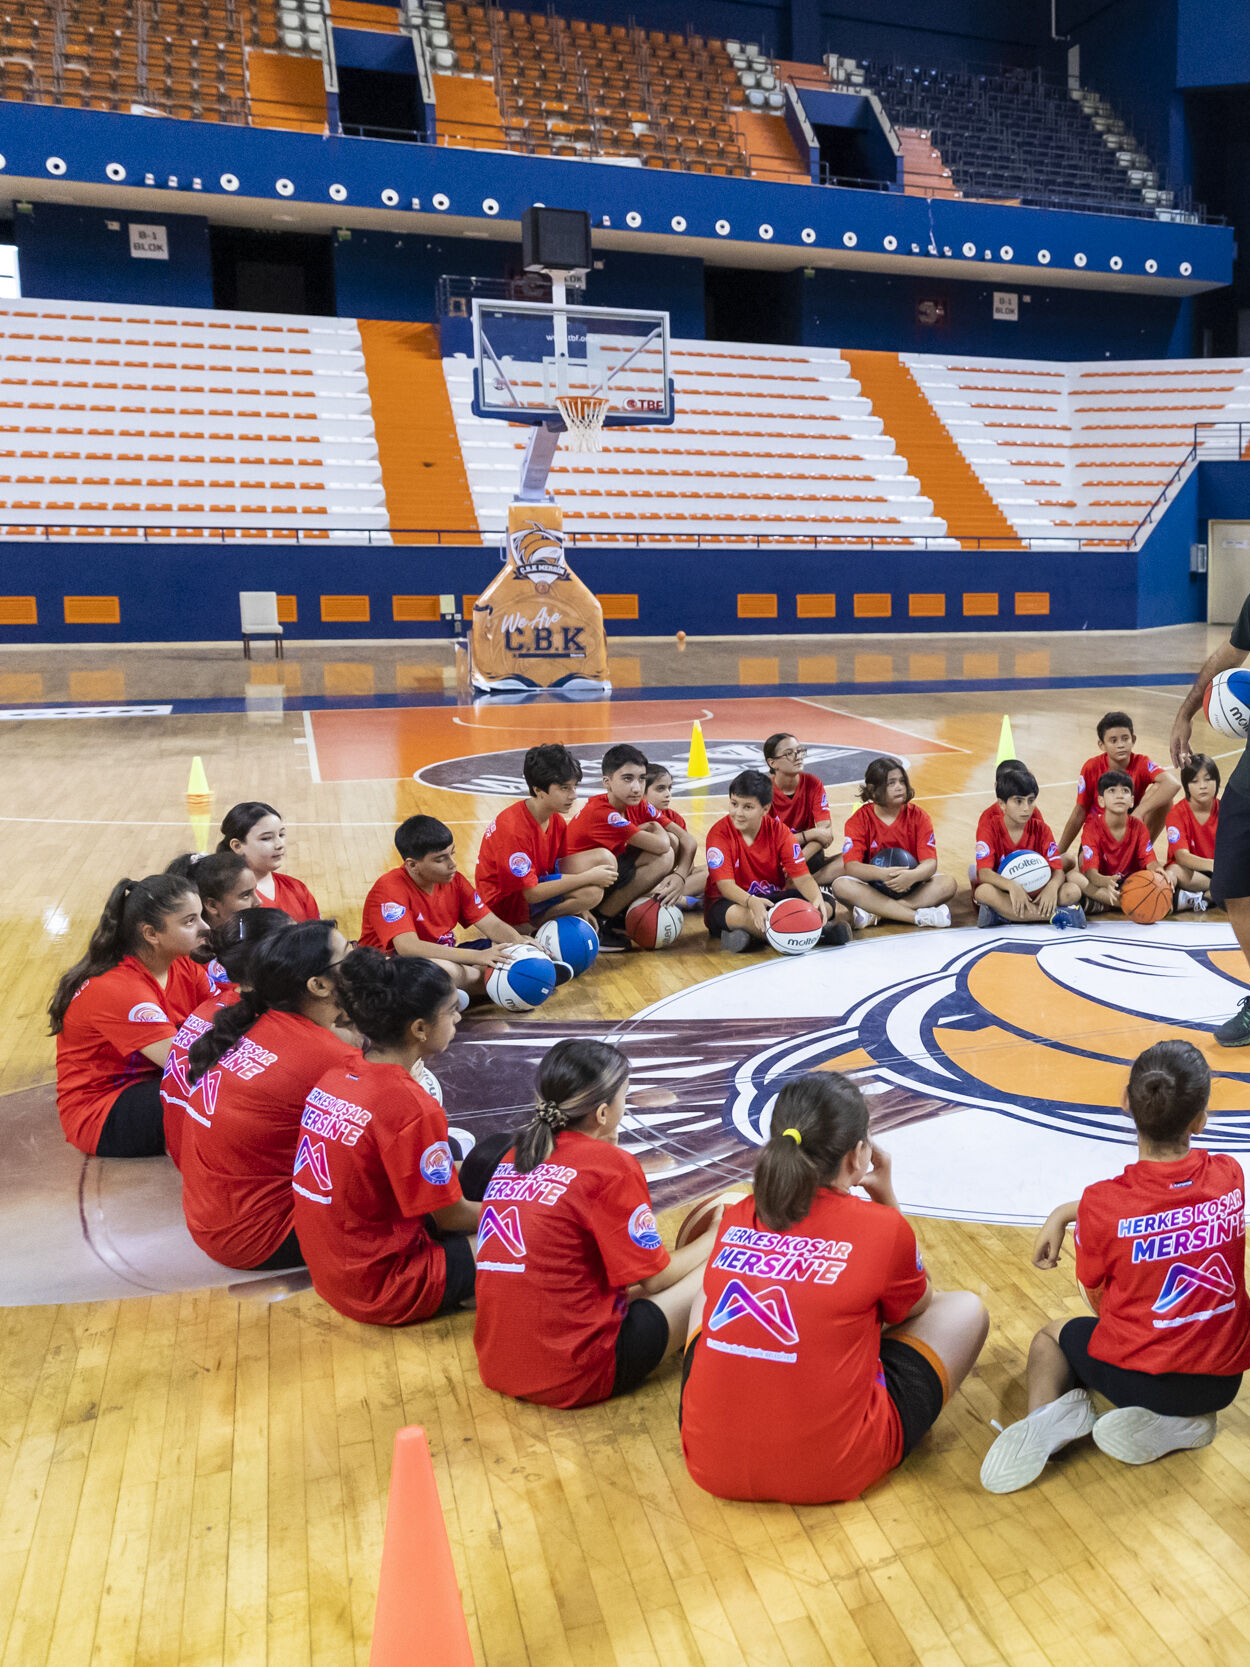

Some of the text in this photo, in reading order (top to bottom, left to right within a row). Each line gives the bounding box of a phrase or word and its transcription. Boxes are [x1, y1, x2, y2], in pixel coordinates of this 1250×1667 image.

[133, 242, 165, 252] BLOK
[138, 231, 158, 240] B-1
[501, 606, 562, 633] We Are
[1009, 858, 1043, 875] molten
[527, 1163, 578, 1185] OŞAR
[485, 1179, 568, 1206] ERSİN'E
[1118, 1188, 1244, 1239] HERKES KOŞAR
[720, 1226, 853, 1259] HERKES KOŞAR
[711, 1246, 847, 1285] MERSİN'E
